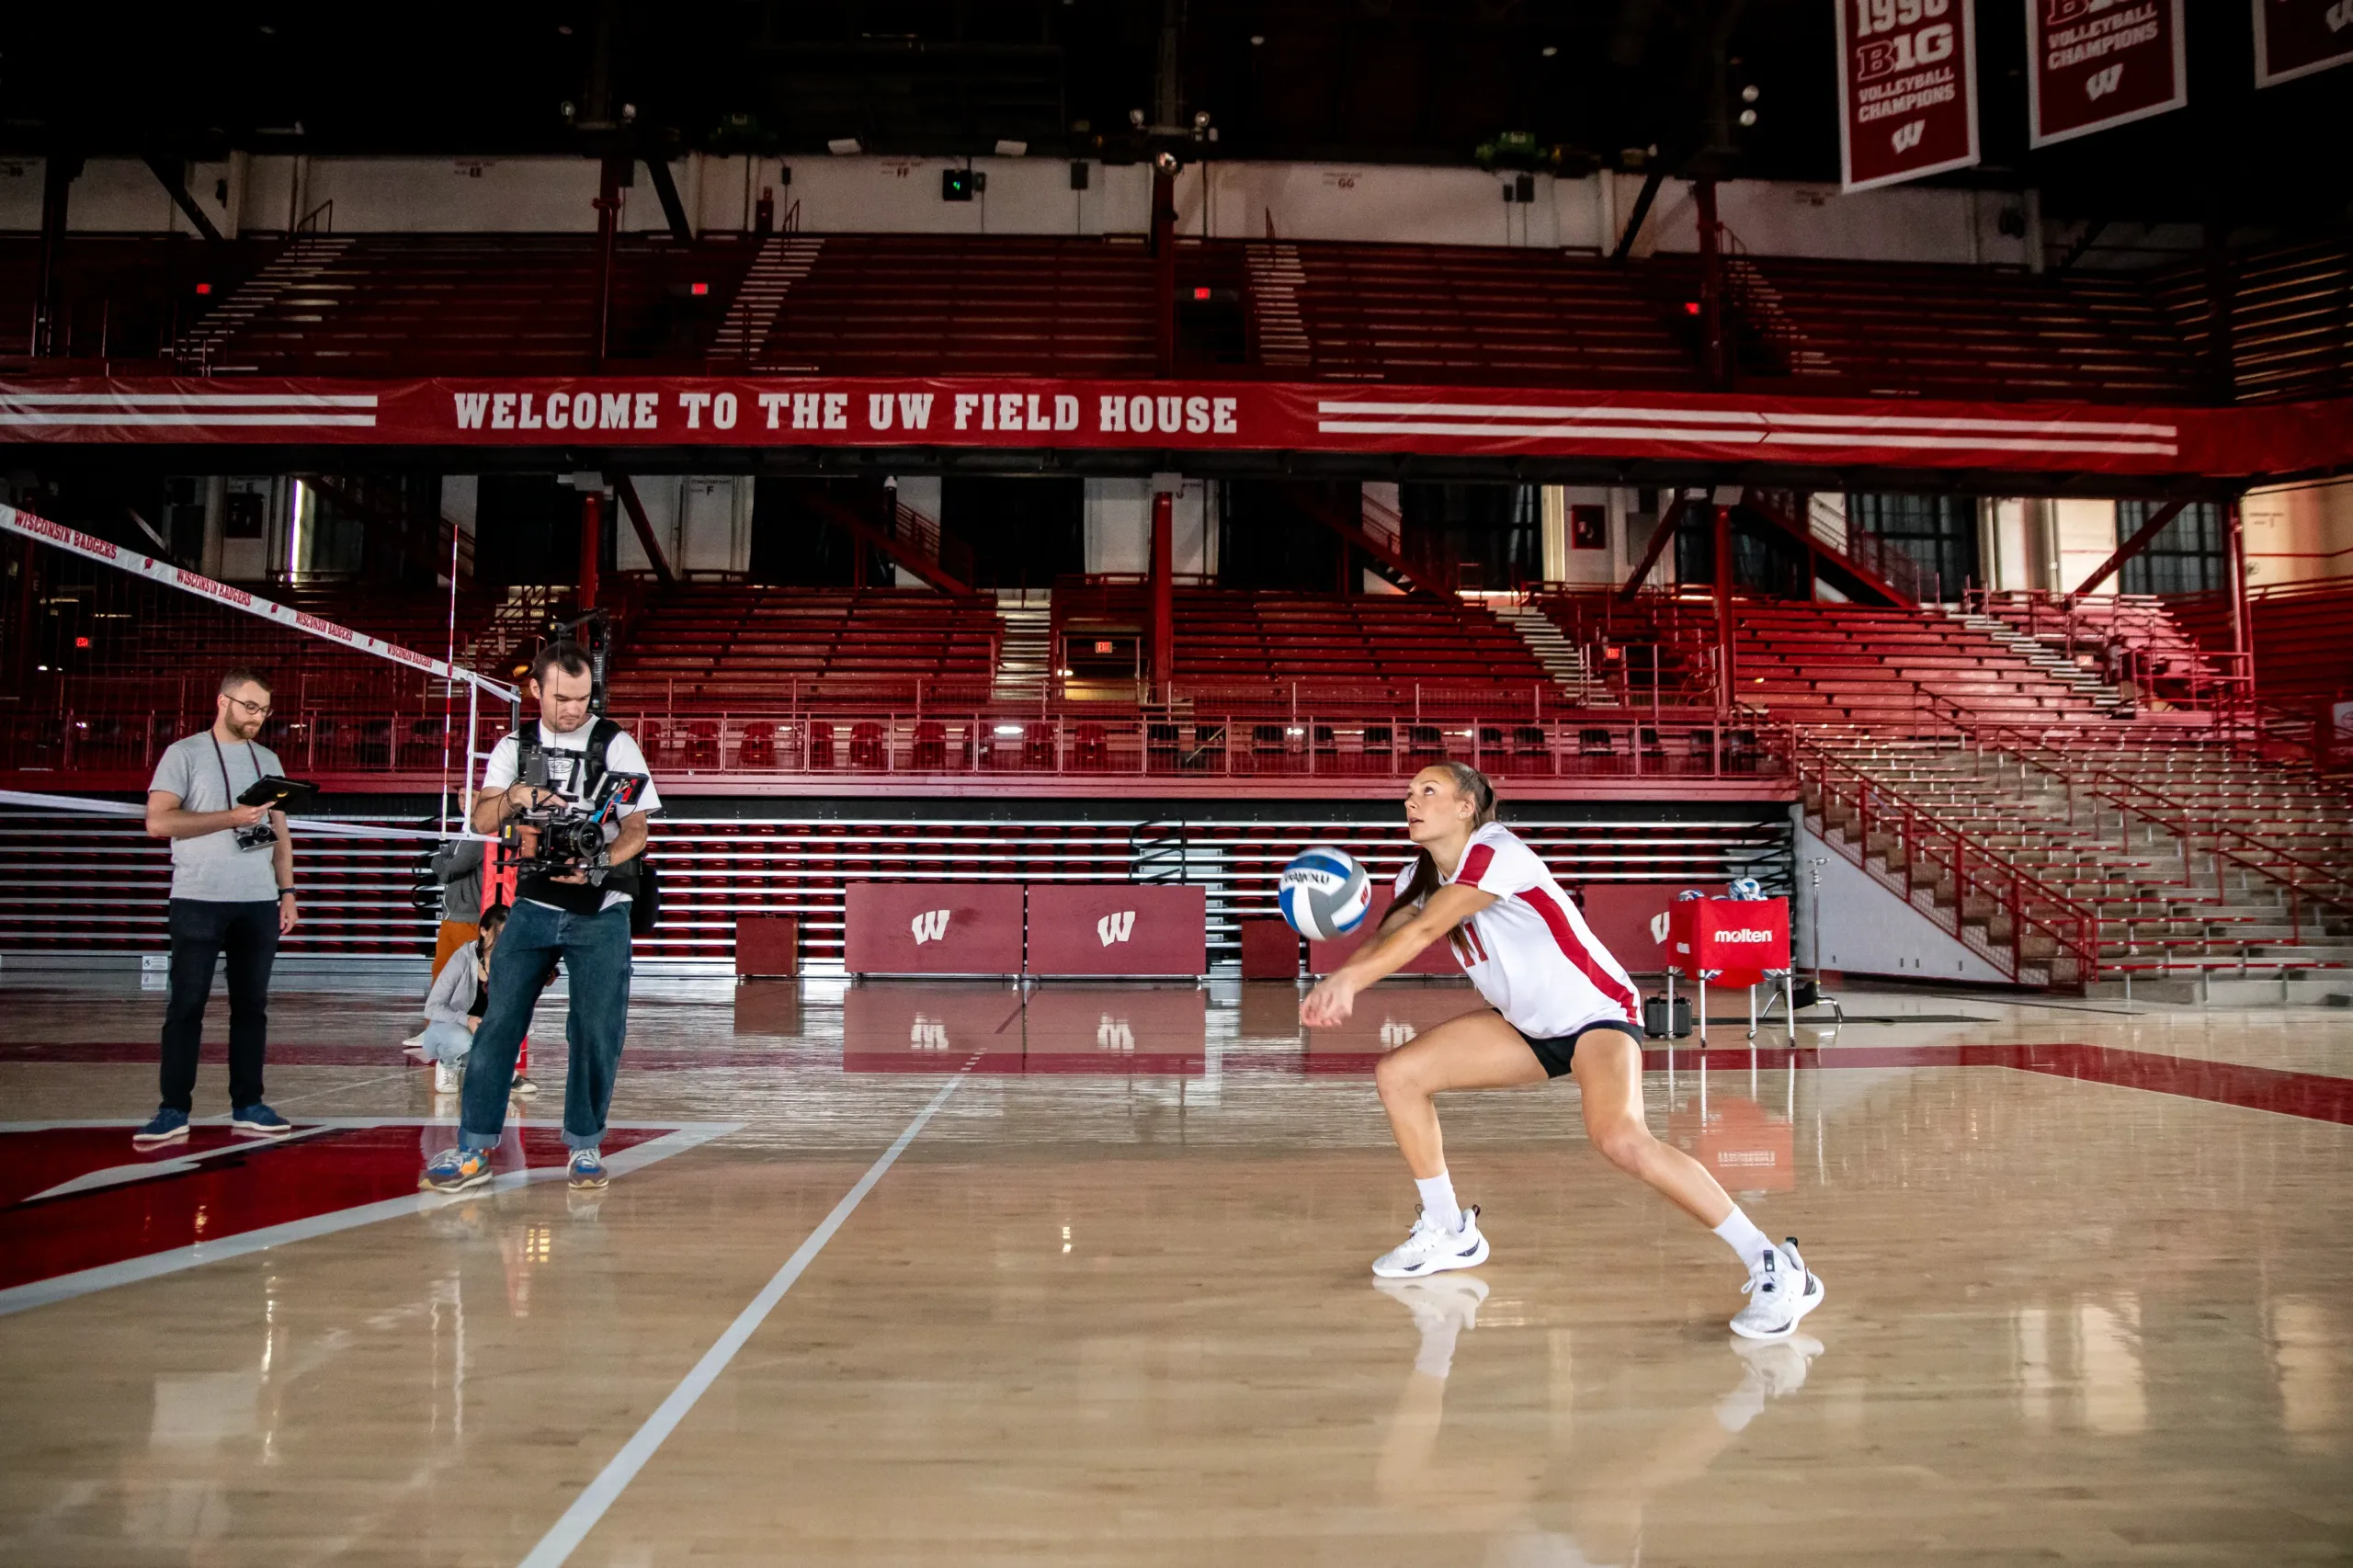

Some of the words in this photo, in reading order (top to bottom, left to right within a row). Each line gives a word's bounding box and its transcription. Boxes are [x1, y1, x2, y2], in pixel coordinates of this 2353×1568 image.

[2047, 20, 2159, 71] CHAMPIONS
[2048, 2, 2158, 50] VOLLEYBALL
[1859, 66, 1955, 104] VOLLEYBALL
[2086, 62, 2125, 102] W
[1858, 83, 1956, 123] CHAMPIONS
[1891, 118, 1926, 154] W
[454, 392, 658, 429] WELCOME
[679, 392, 737, 430] TO
[758, 392, 847, 430] THE
[869, 393, 934, 430] UW
[954, 393, 1079, 431] FIELD
[1099, 395, 1237, 434] HOUSE
[15, 509, 71, 543] WISCONSIN
[74, 530, 118, 560] BADGERS
[176, 568, 218, 594] WISCONSIN
[219, 584, 252, 607] BADGERS
[296, 611, 327, 632] WISCONSIN
[328, 622, 353, 642] BADGERS
[912, 909, 950, 945] W
[1097, 911, 1135, 947] W
[1714, 928, 1772, 943] molten
